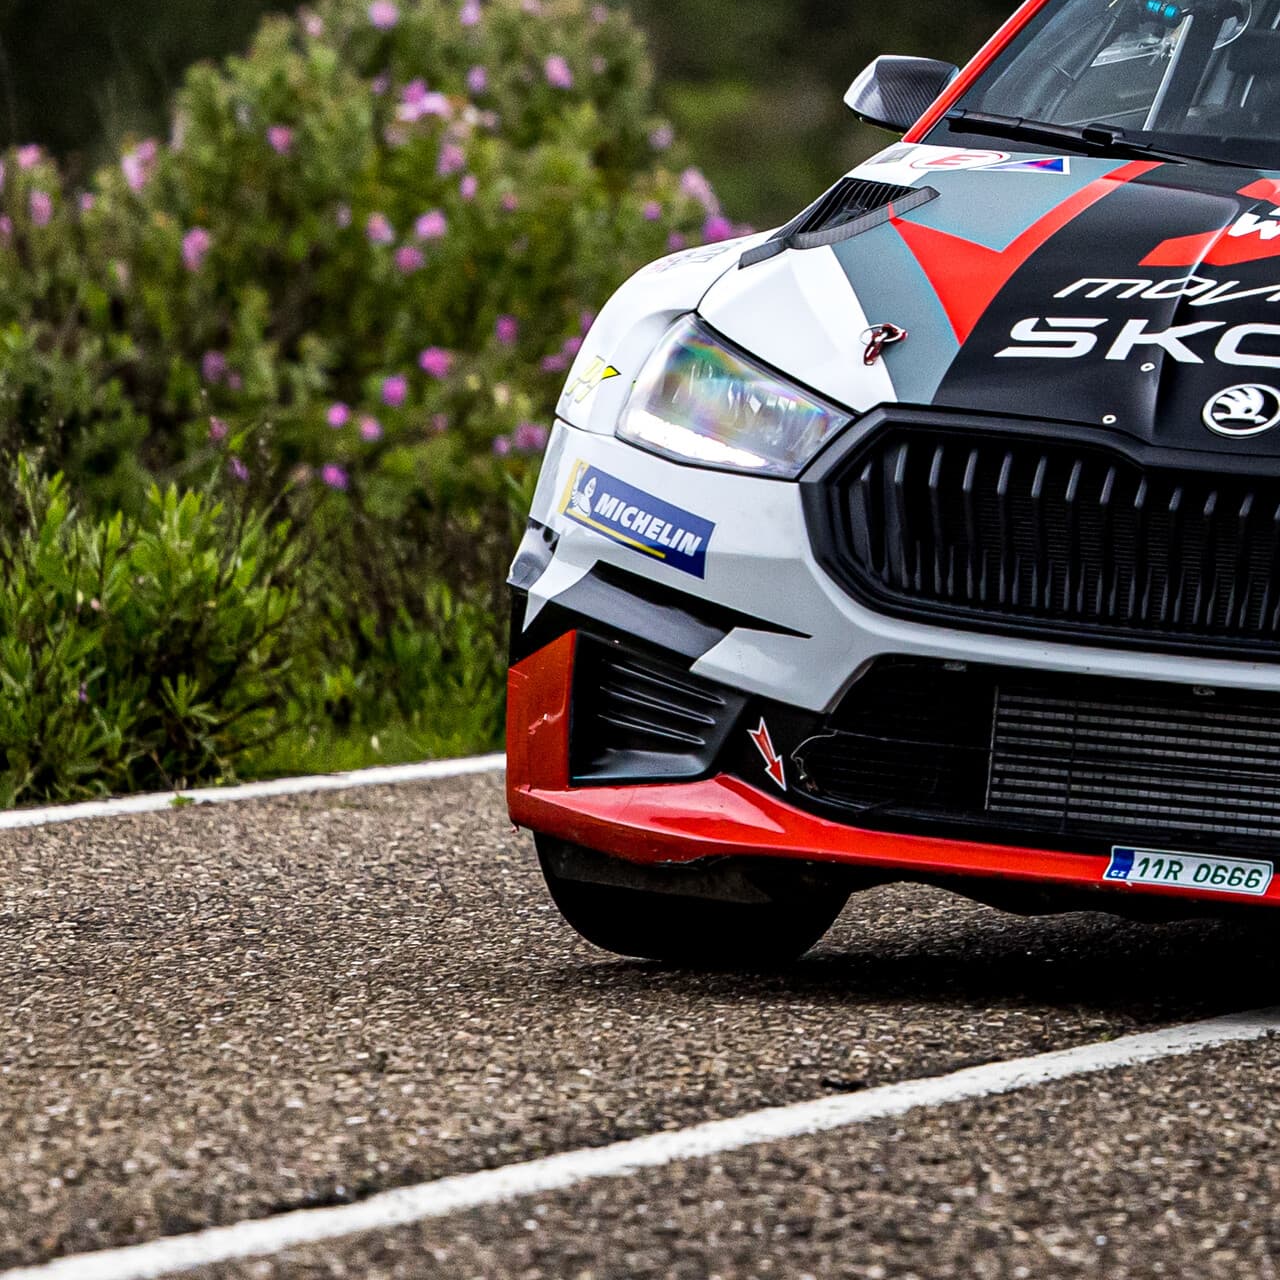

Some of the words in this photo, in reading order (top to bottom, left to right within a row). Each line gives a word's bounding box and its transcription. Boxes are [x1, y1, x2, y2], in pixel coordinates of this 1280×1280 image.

[593, 492, 703, 558] MICHELIN
[1110, 869, 1126, 878] CZ
[1137, 857, 1184, 881] 11R
[1192, 863, 1263, 889] 0666
